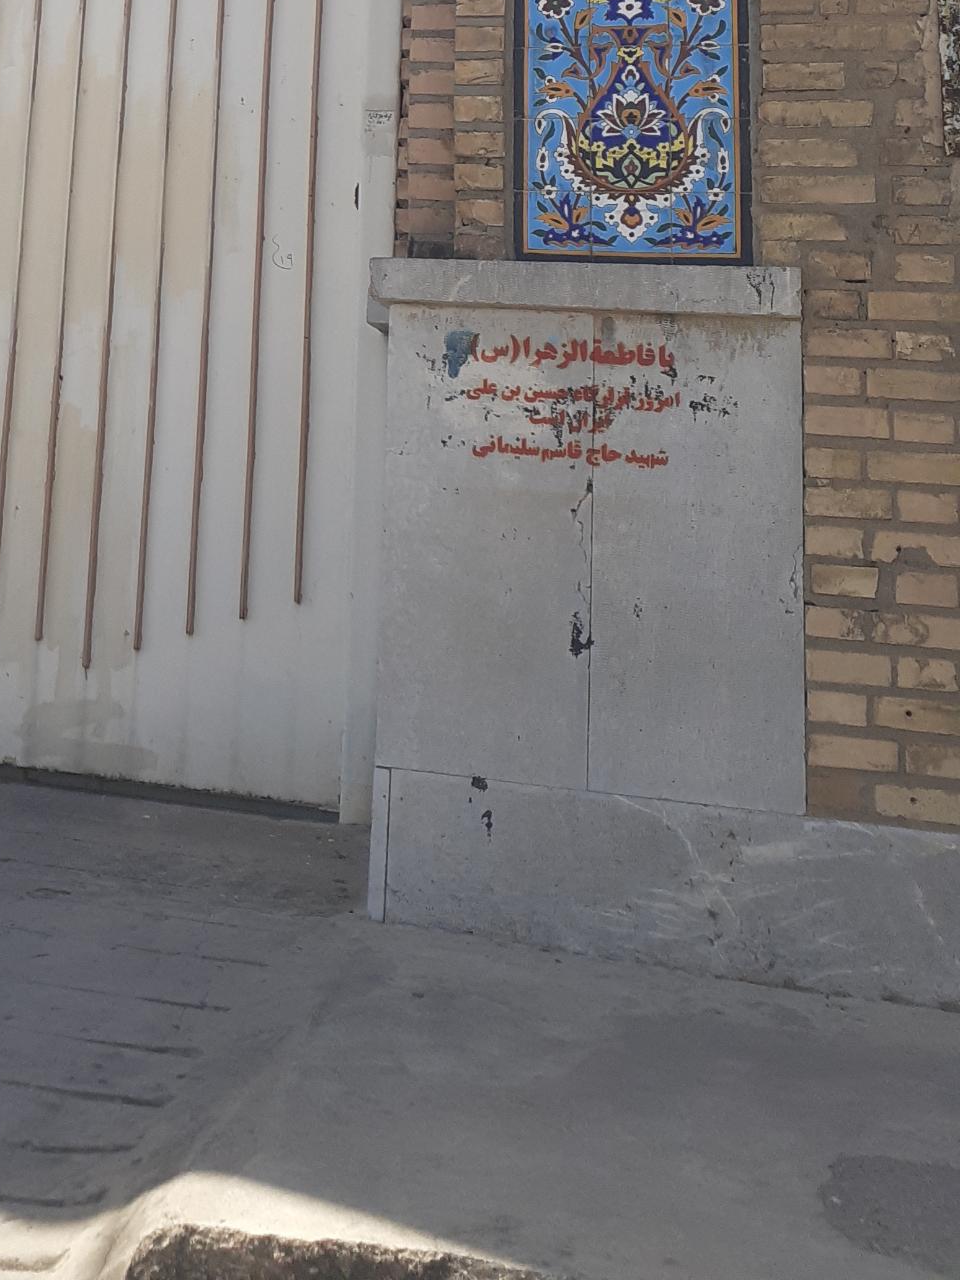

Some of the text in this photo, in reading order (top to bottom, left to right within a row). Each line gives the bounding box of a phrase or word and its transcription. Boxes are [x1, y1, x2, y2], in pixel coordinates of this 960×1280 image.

[501, 385, 521, 402] بن
[541, 439, 583, 463] قاسم
[586, 443, 622, 466] حاج
[625, 448, 670, 469] شهید
